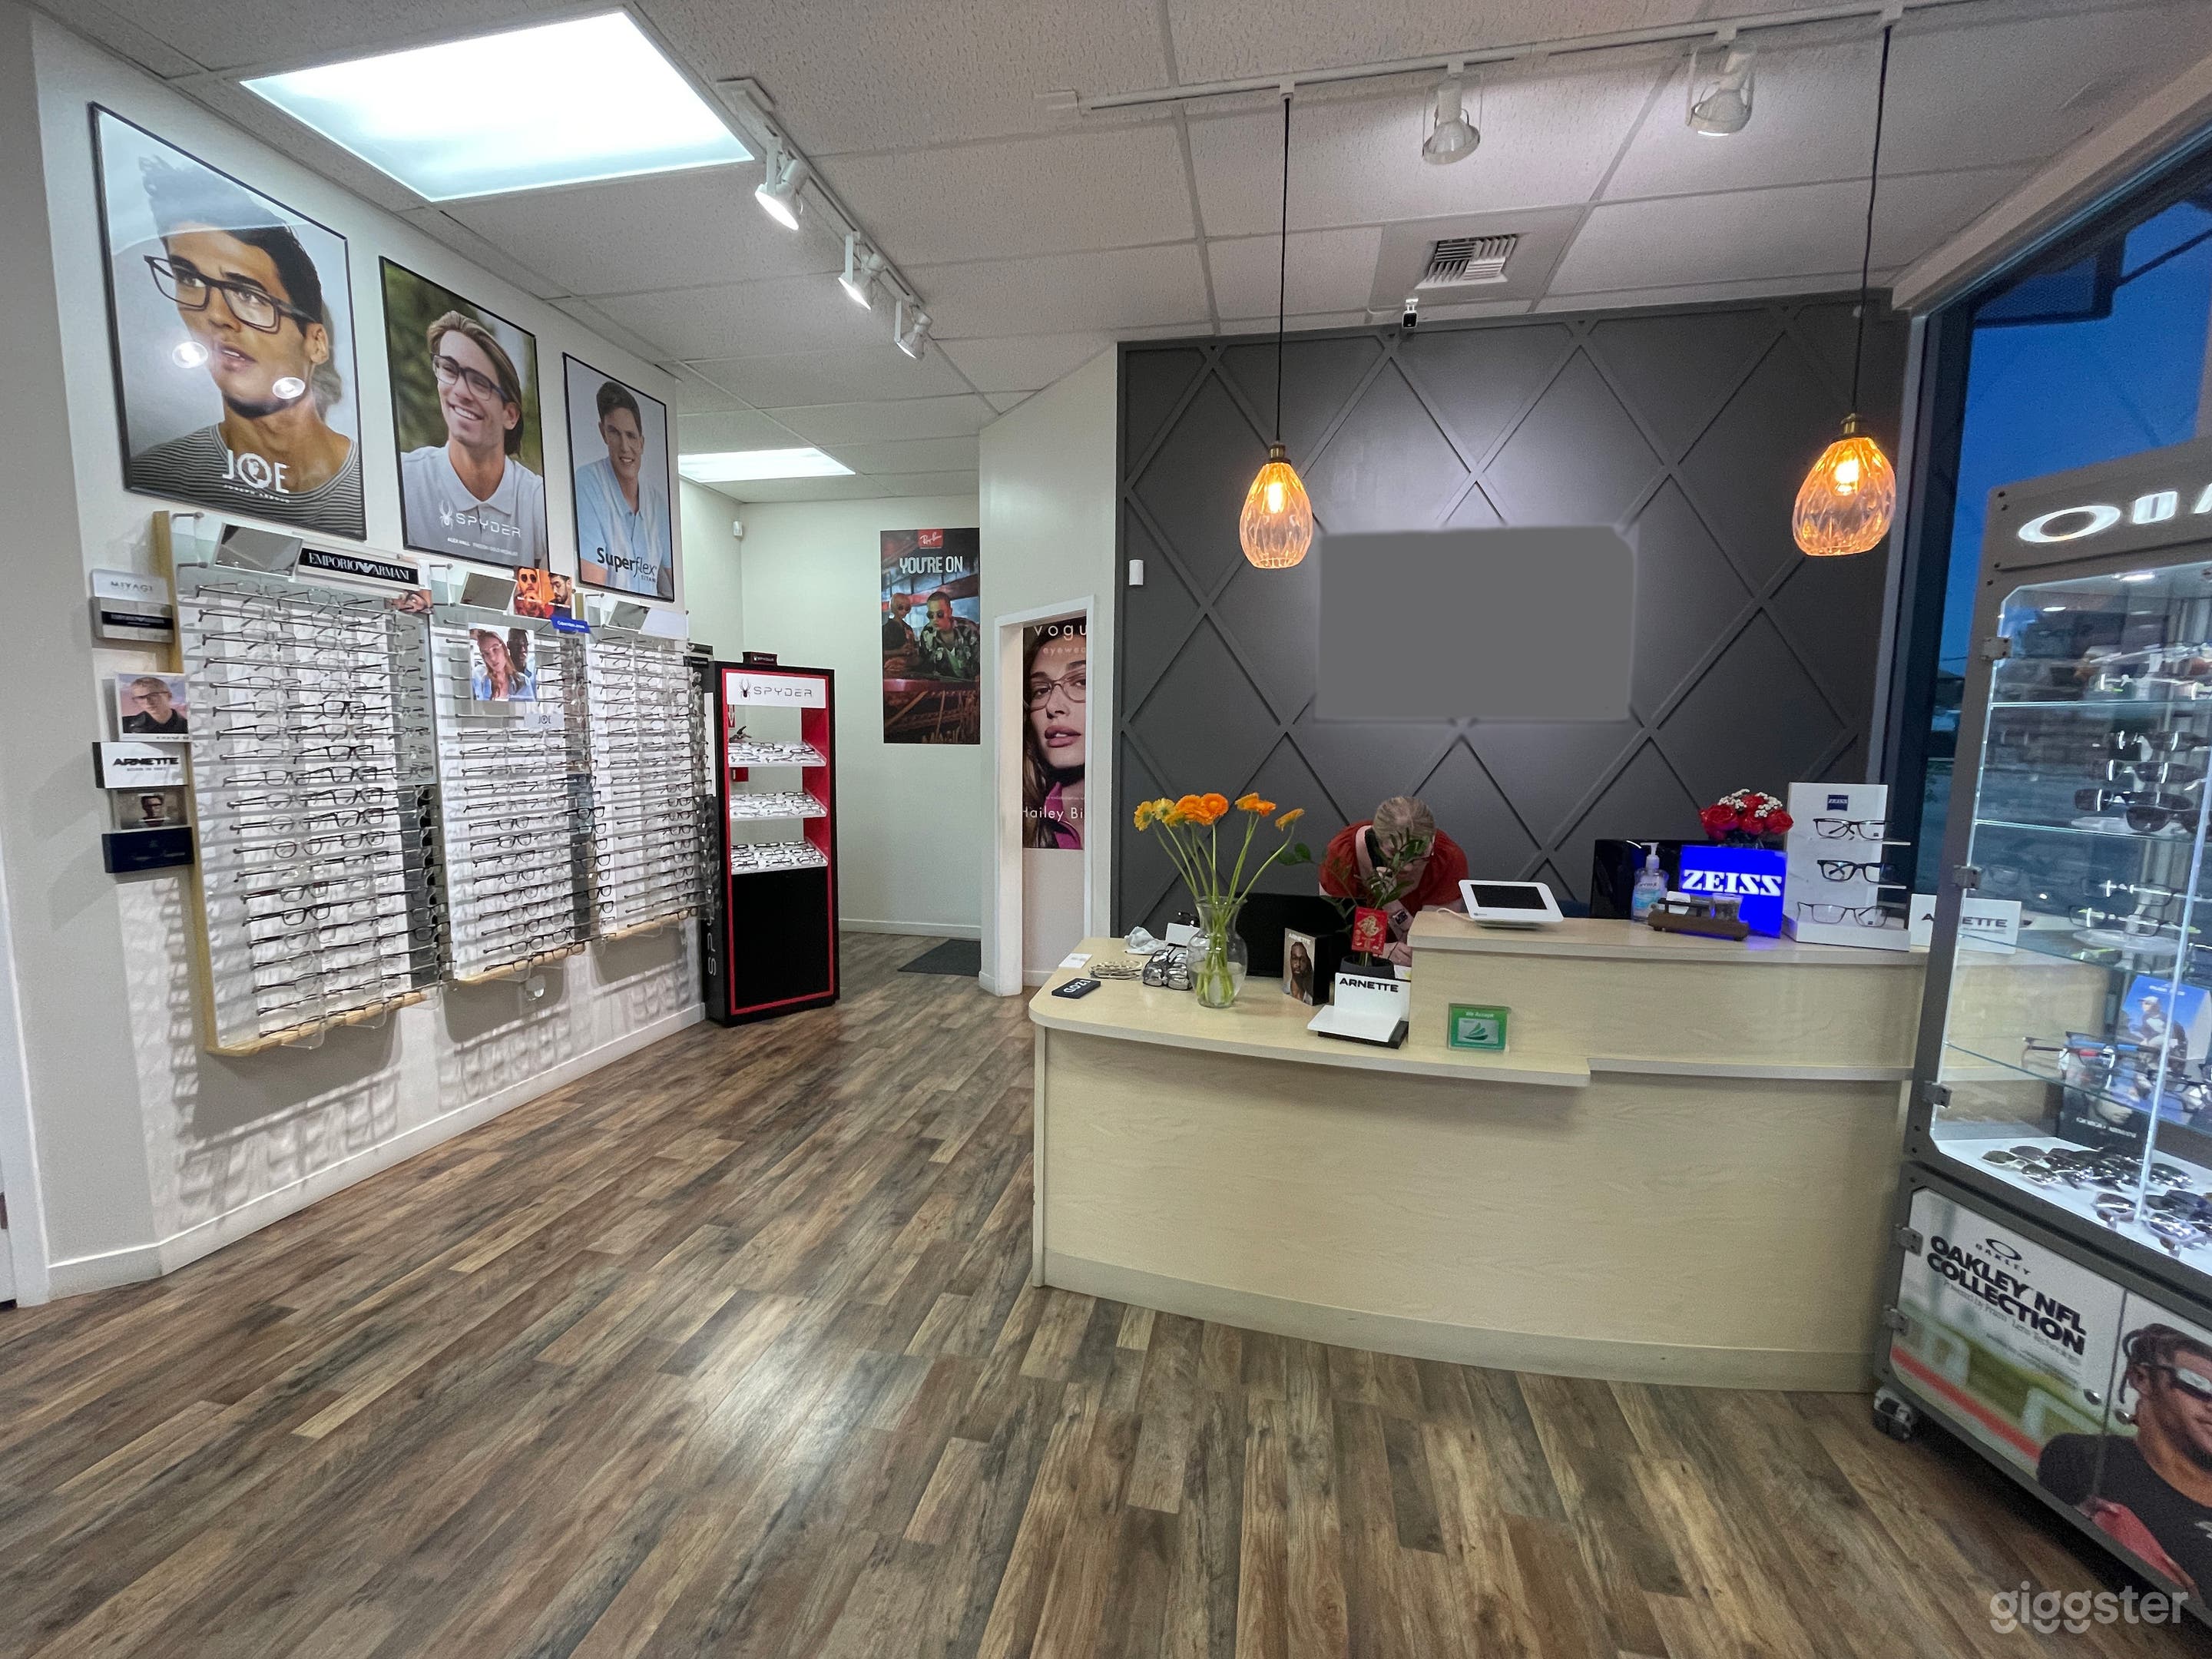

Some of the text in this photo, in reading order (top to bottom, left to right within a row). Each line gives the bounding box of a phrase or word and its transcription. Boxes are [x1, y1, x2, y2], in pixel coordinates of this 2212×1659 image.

[223, 449, 290, 494] JOE
[455, 512, 521, 538] SPYDER
[309, 552, 409, 581] EMPORIO ARMANI
[899, 555, 963, 575] YOU'RE ON
[753, 686, 813, 698] SPYDER
[113, 757, 179, 766] ARNETTE
[1682, 869, 1783, 897] ZEISS
[1339, 977, 1399, 993] ARNETTE
[1975, 1243, 2031, 1275] OAKLEY
[1930, 1235, 2087, 1336] OAKLEY NFL
[1927, 1252, 2085, 1356] COLLECTION
